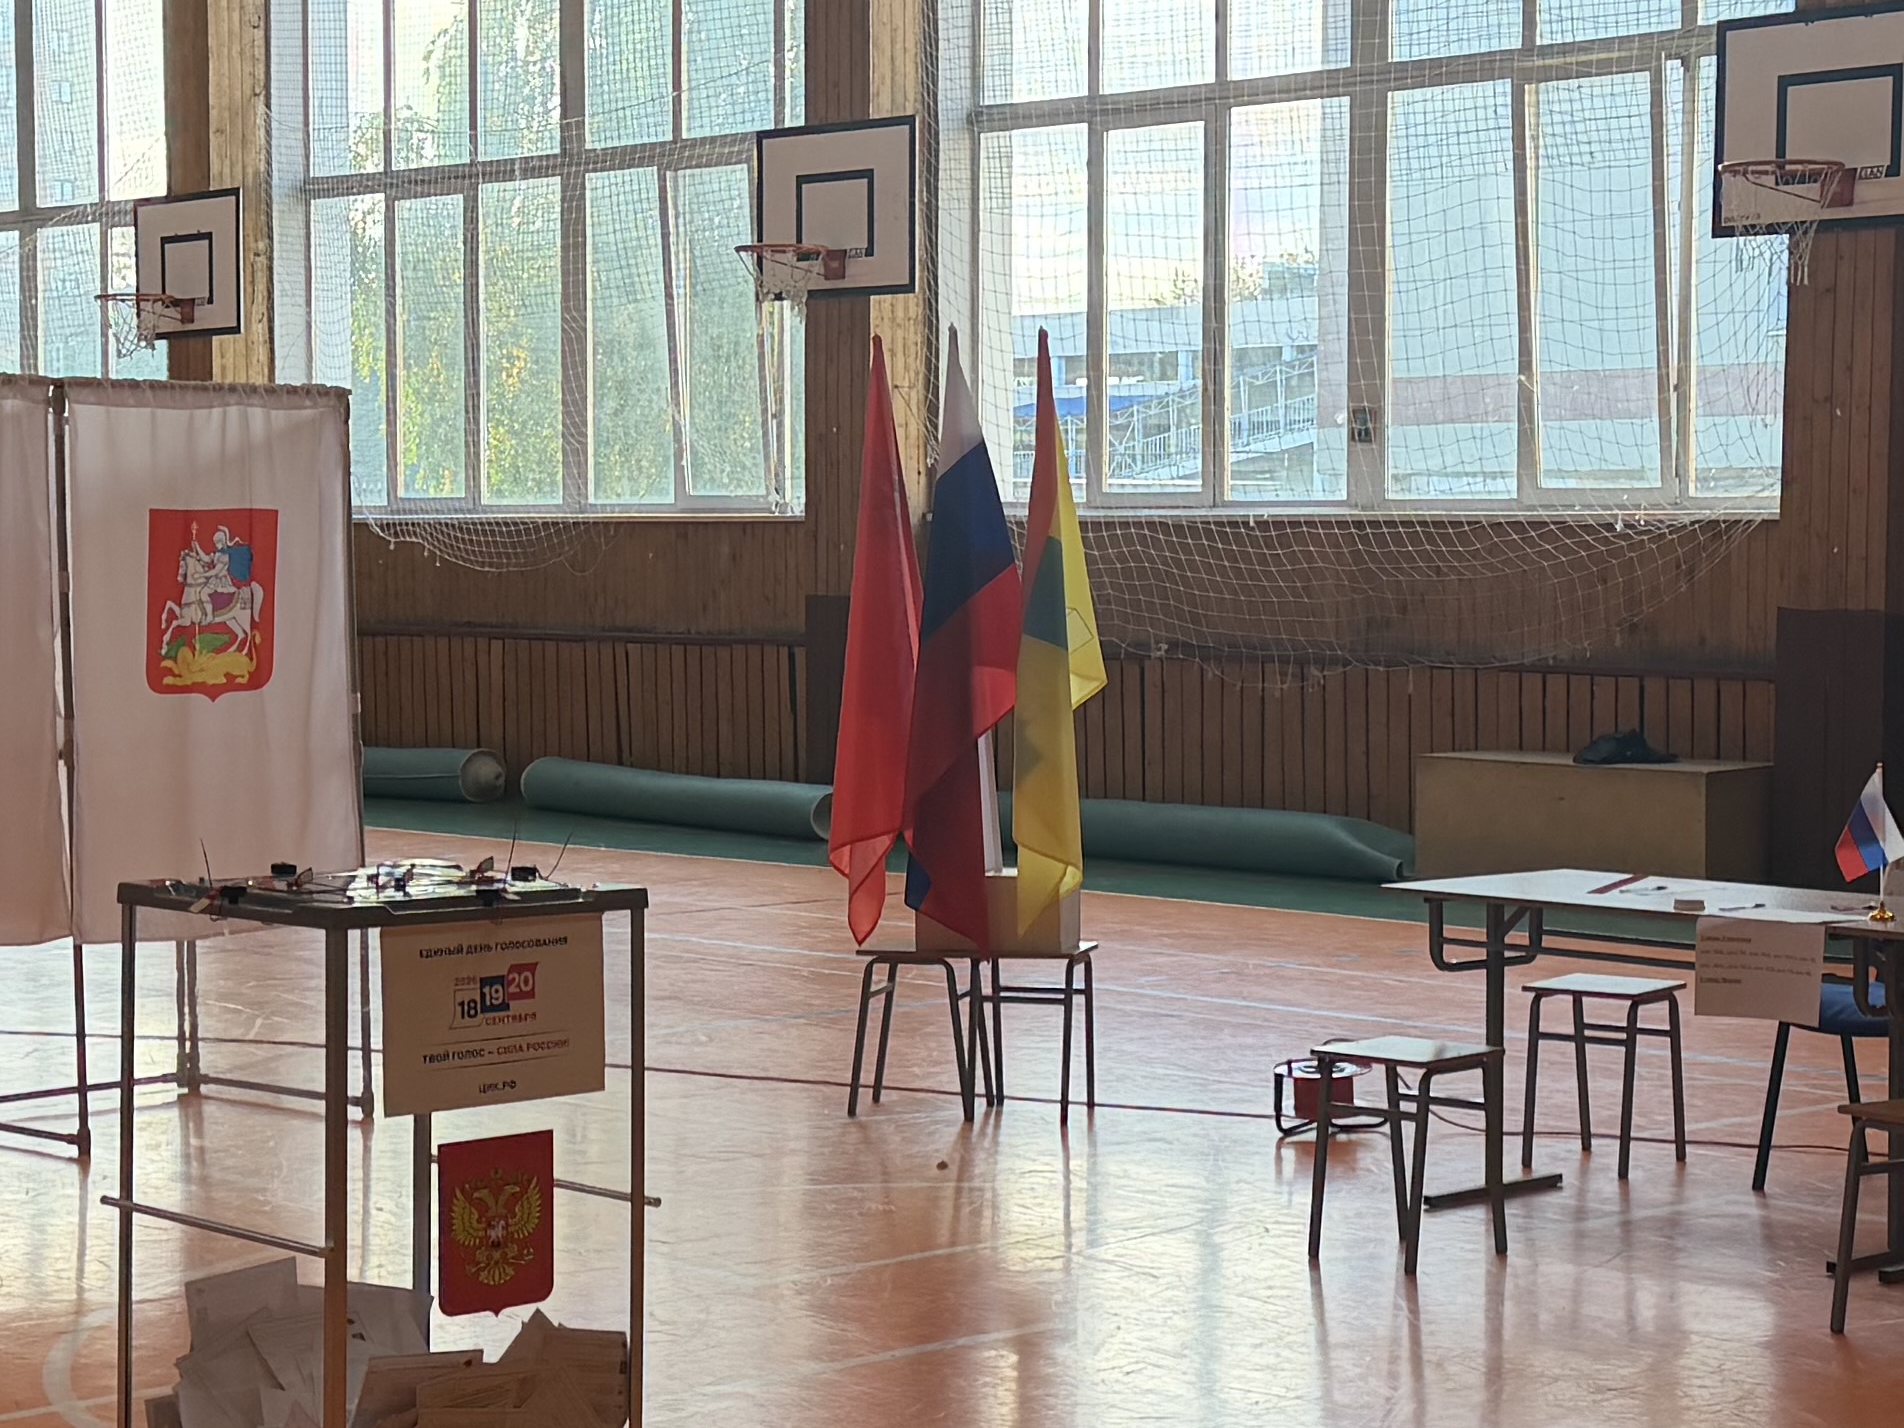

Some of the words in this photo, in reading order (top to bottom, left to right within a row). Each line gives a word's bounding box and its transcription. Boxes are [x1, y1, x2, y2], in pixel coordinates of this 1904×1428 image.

[458, 999, 478, 1019] 18
[483, 984, 504, 1006] 19
[508, 971, 533, 993] 20
